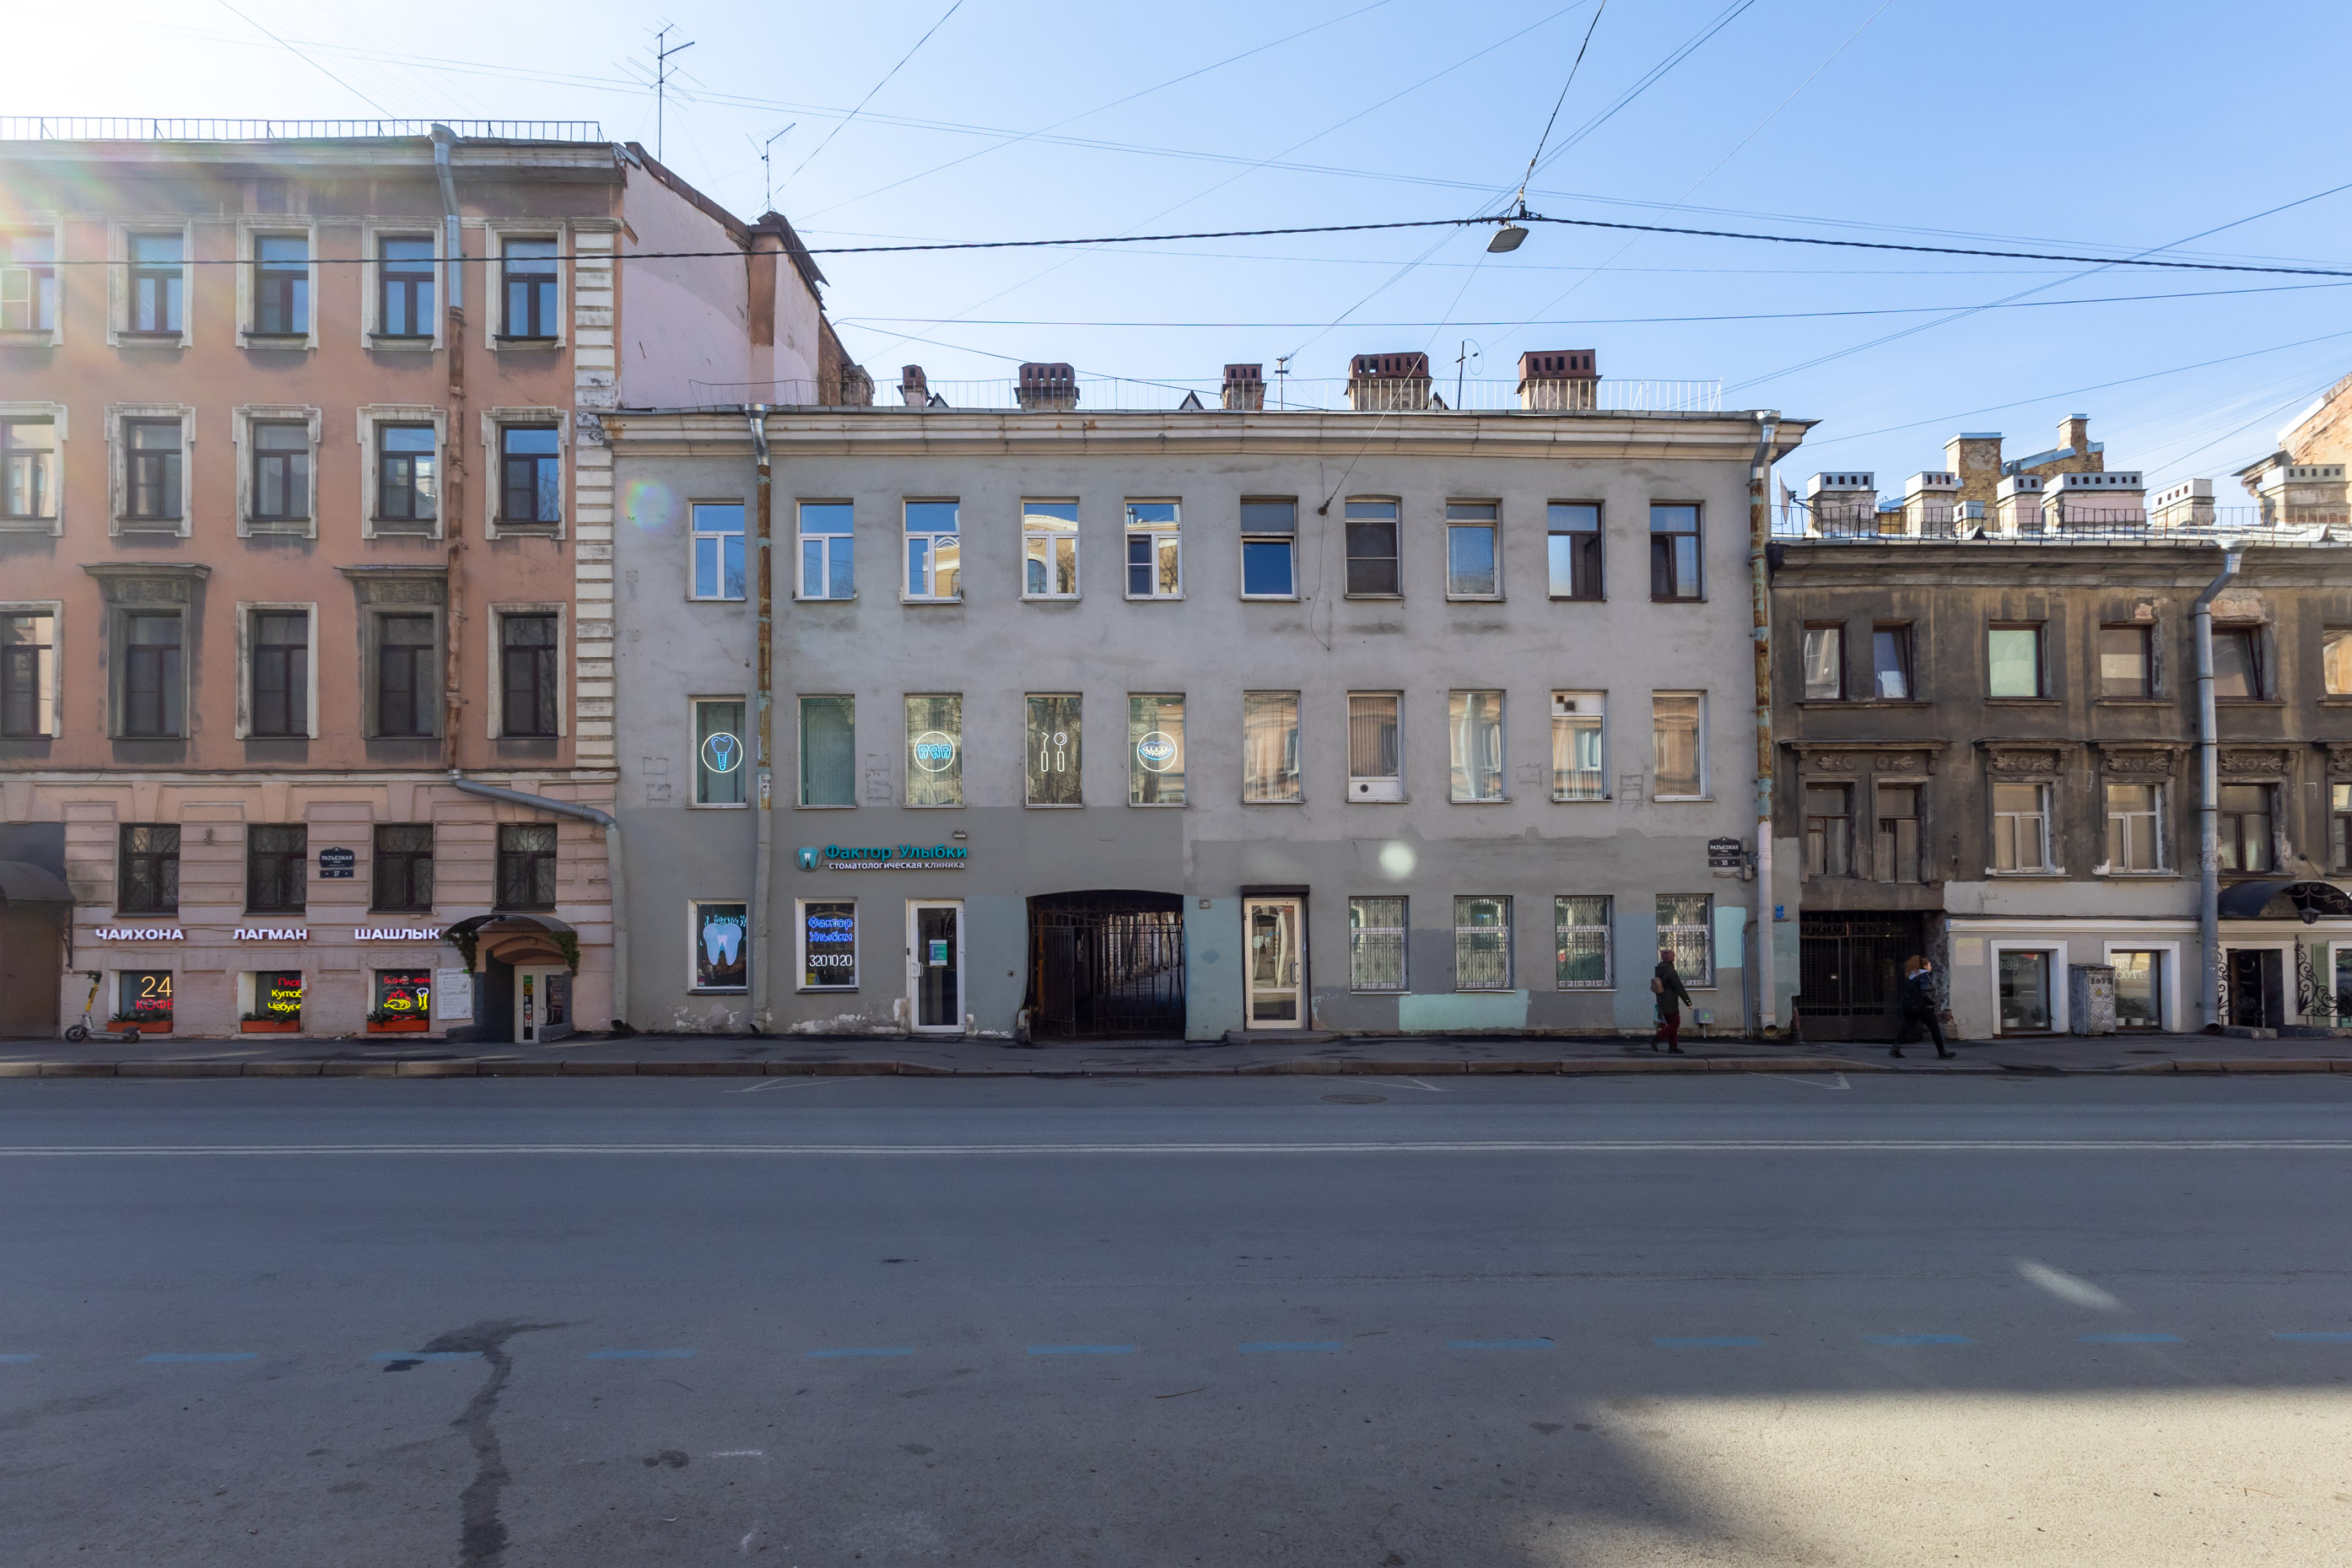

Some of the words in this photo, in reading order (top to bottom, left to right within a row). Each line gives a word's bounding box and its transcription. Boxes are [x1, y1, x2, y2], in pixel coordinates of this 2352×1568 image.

[825, 844, 892, 861] Фактор
[898, 844, 967, 859] Улыбки
[828, 861, 921, 870] стоматологическая
[924, 860, 964, 869] клиника
[808, 916, 853, 930] Фактор
[233, 929, 308, 940] ЛАГМАН
[354, 929, 440, 940] ШАШЛЫК
[809, 931, 853, 942] Улыбки
[141, 976, 173, 997] 24
[136, 999, 174, 1010] КОФЕ
